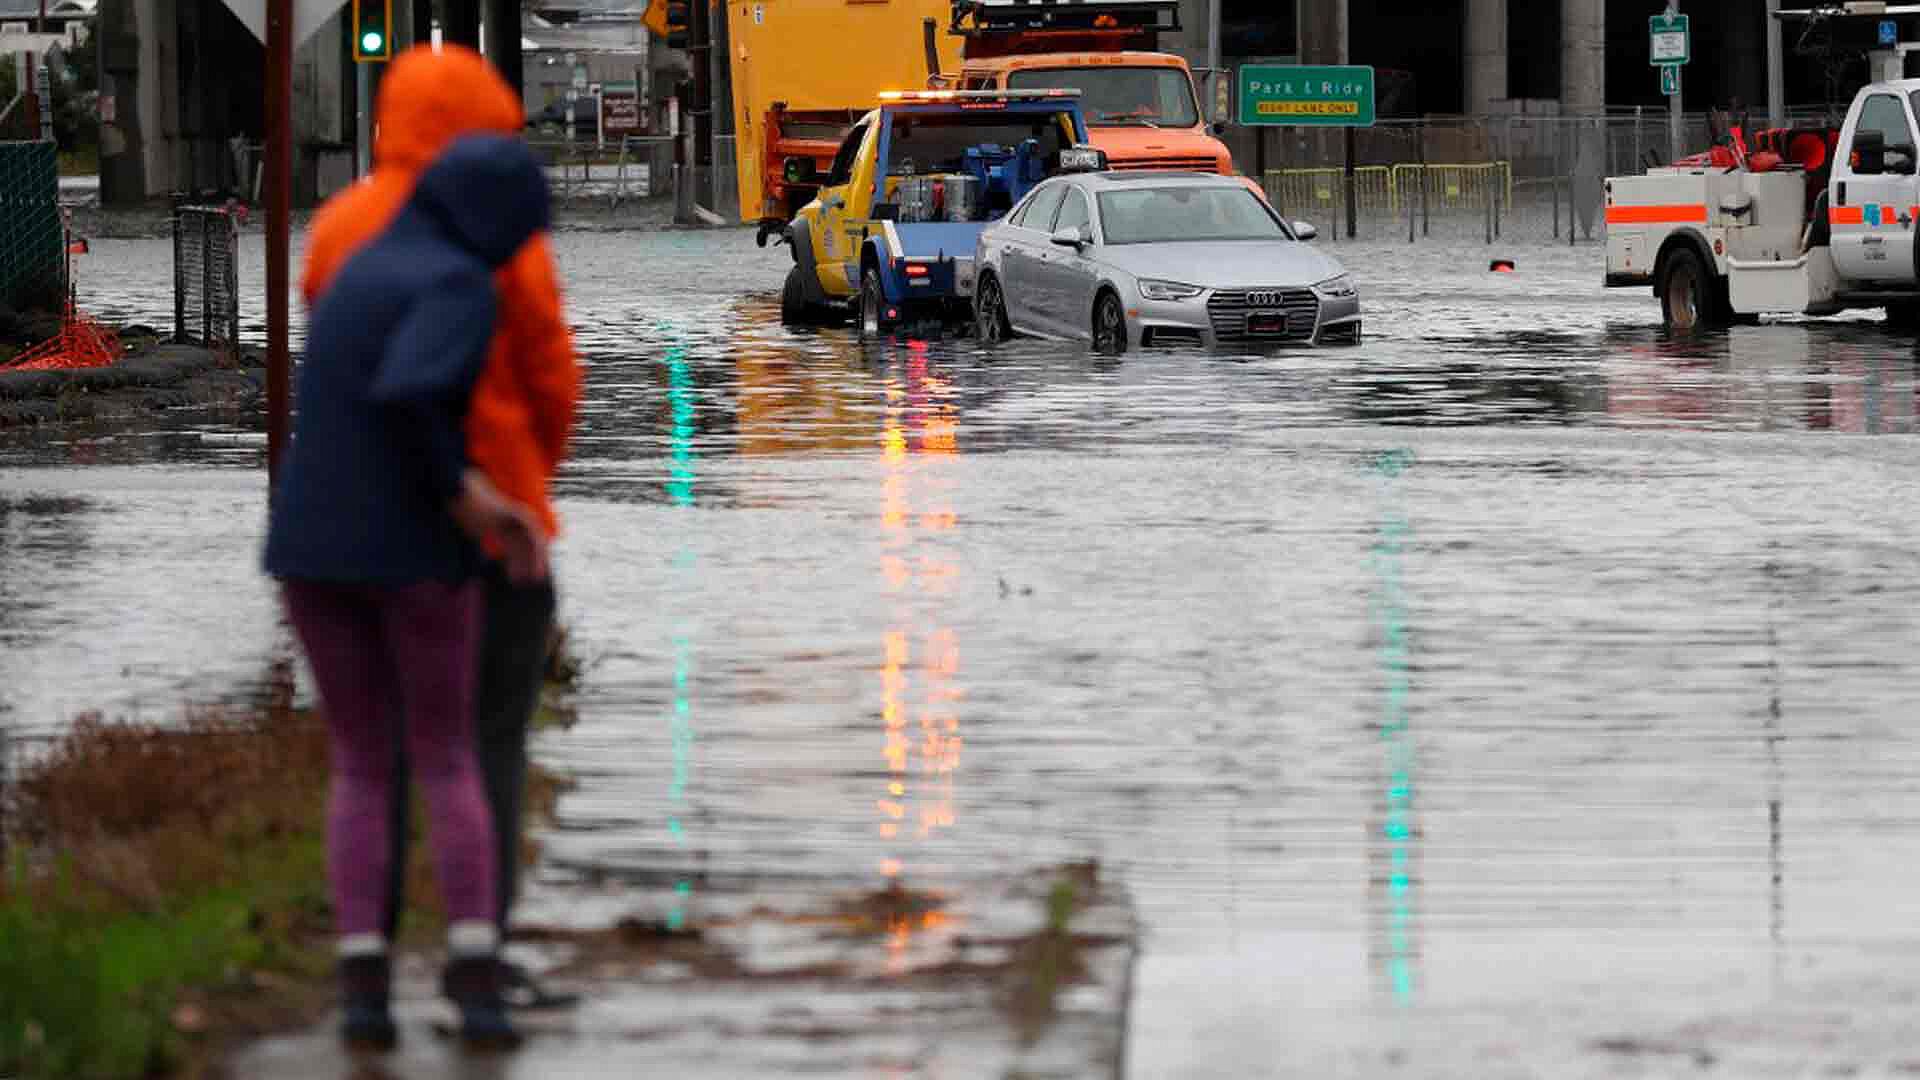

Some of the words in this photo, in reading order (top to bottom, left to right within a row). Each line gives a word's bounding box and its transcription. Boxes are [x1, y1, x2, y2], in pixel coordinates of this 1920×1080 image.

[1249, 80, 1294, 95] Park
[1321, 80, 1364, 95] Ride
[1295, 103, 1324, 113] LANE
[1327, 103, 1355, 113] ONLY
